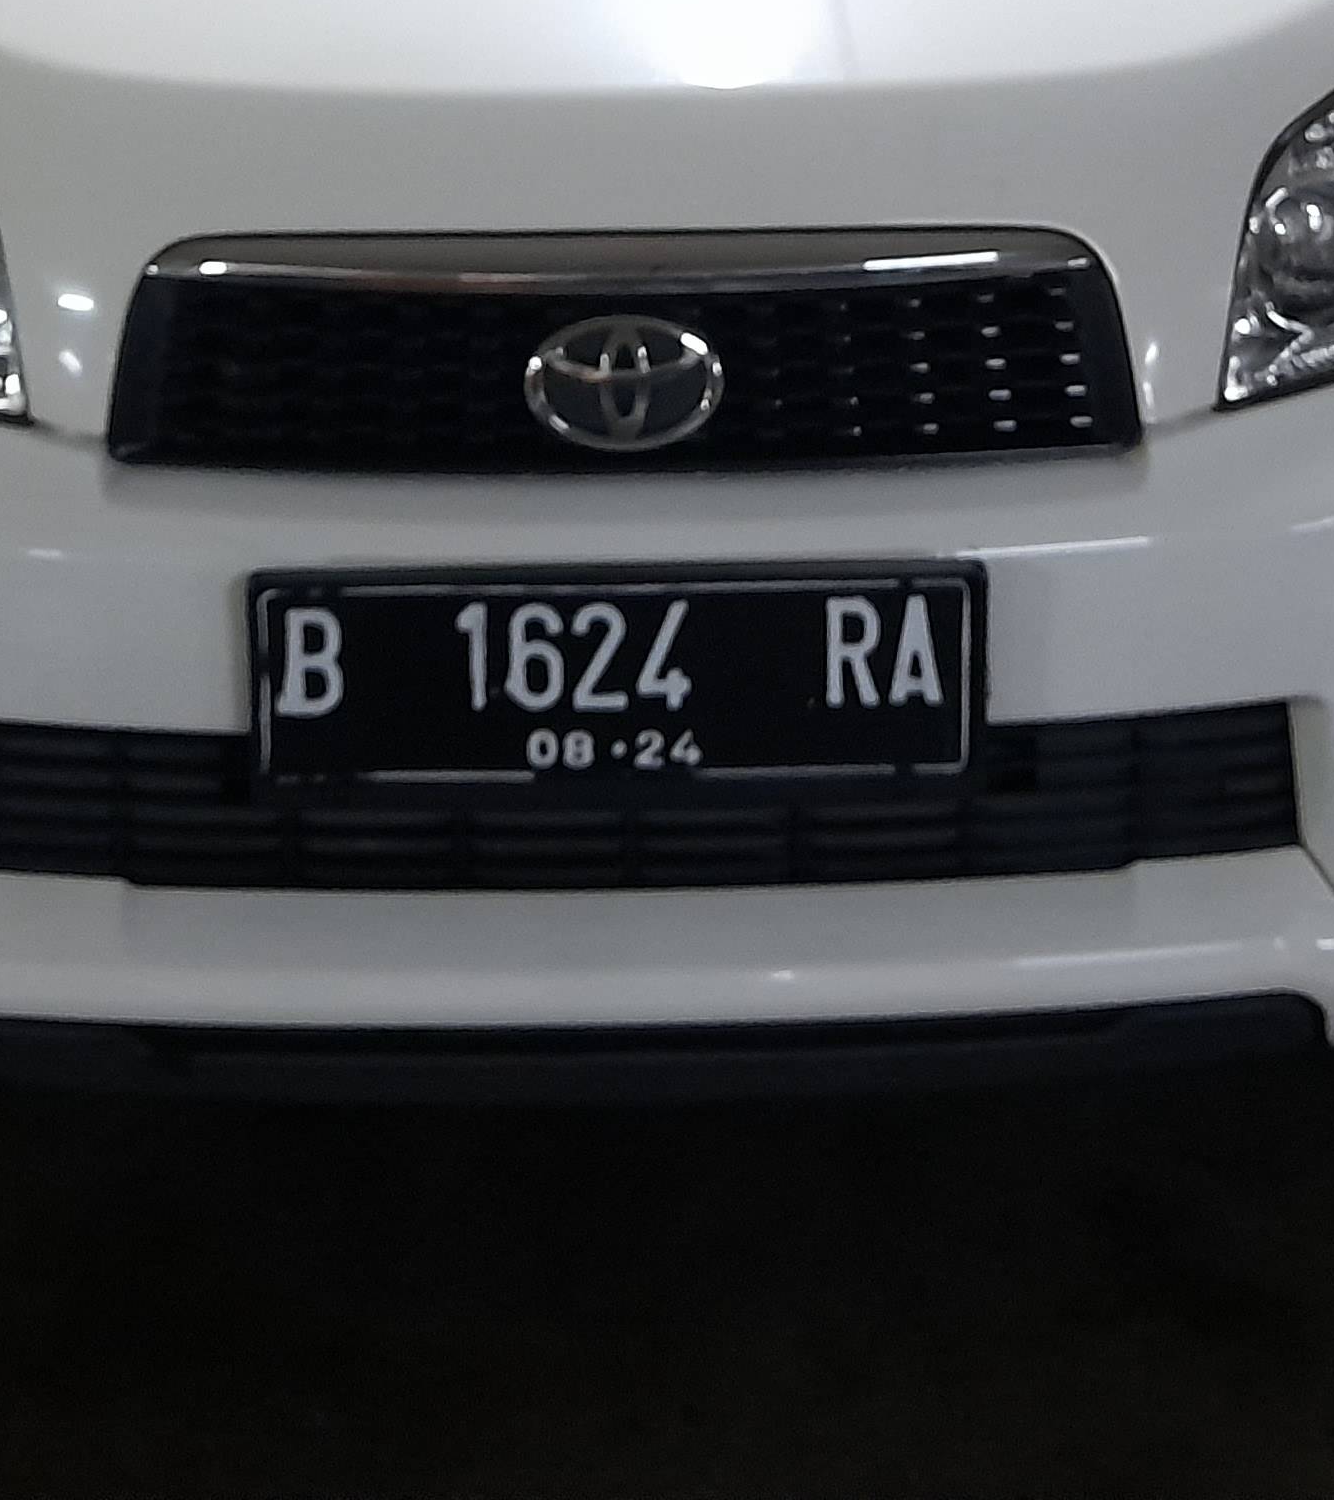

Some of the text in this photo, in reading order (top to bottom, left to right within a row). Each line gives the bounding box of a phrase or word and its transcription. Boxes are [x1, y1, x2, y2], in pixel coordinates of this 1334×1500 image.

[275, 593, 945, 718] B 1624 RA
